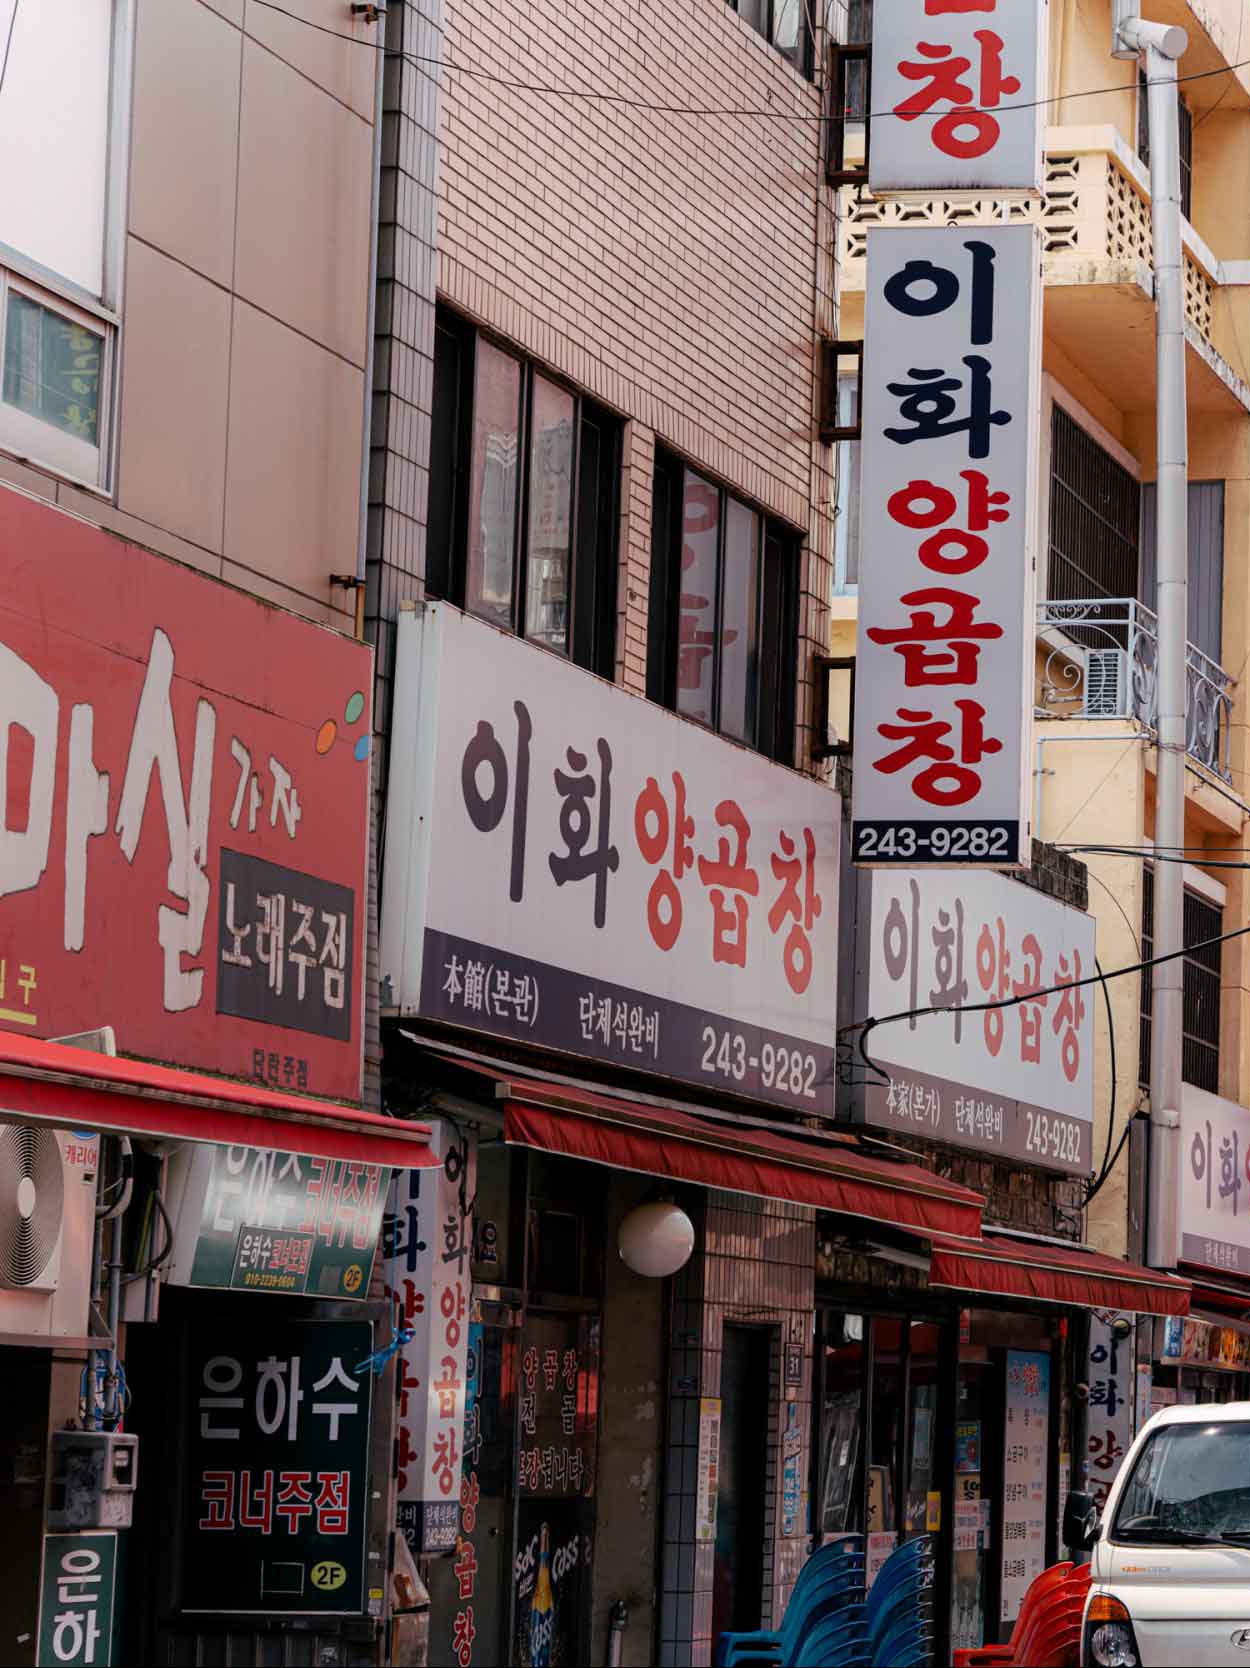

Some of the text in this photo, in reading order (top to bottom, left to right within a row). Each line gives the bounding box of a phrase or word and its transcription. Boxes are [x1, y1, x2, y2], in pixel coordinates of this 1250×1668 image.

[893, 0, 1020, 159] 창
[859, 827, 1009, 857] 243-9282
[222, 882, 347, 1008] 노래주점
[0, 958, 37, 1006] 구
[579, 992, 659, 1058] 단체석완비
[701, 1027, 817, 1099] 243-9282
[65, 1144, 98, 1168] 캐리어
[955, 1096, 1003, 1144] 단체석완비
[1026, 1111, 1081, 1163] 243-9282
[789, 1356, 800, 1370] 31
[200, 1353, 361, 1442] 은하수
[200, 1471, 350, 1534] 코너주점
[317, 1566, 342, 1585] 2F
